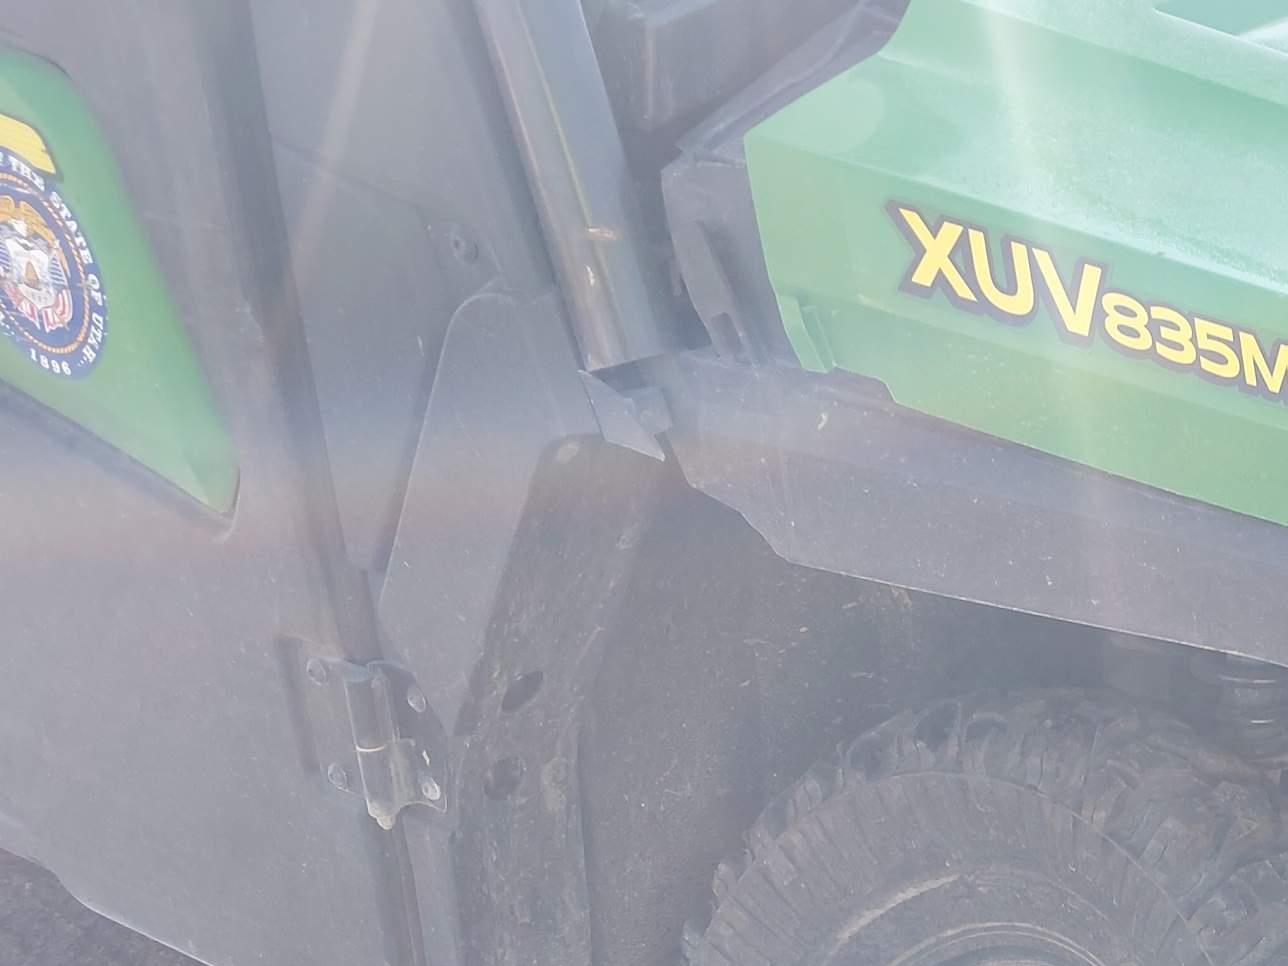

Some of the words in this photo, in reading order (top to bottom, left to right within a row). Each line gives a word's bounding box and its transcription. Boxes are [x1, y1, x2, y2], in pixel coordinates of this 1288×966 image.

[8, 155, 46, 192] THE
[50, 191, 94, 265] STATE
[87, 273, 104, 306] OF
[82, 312, 104, 364] UTAH
[29, 347, 73, 376] 1896
